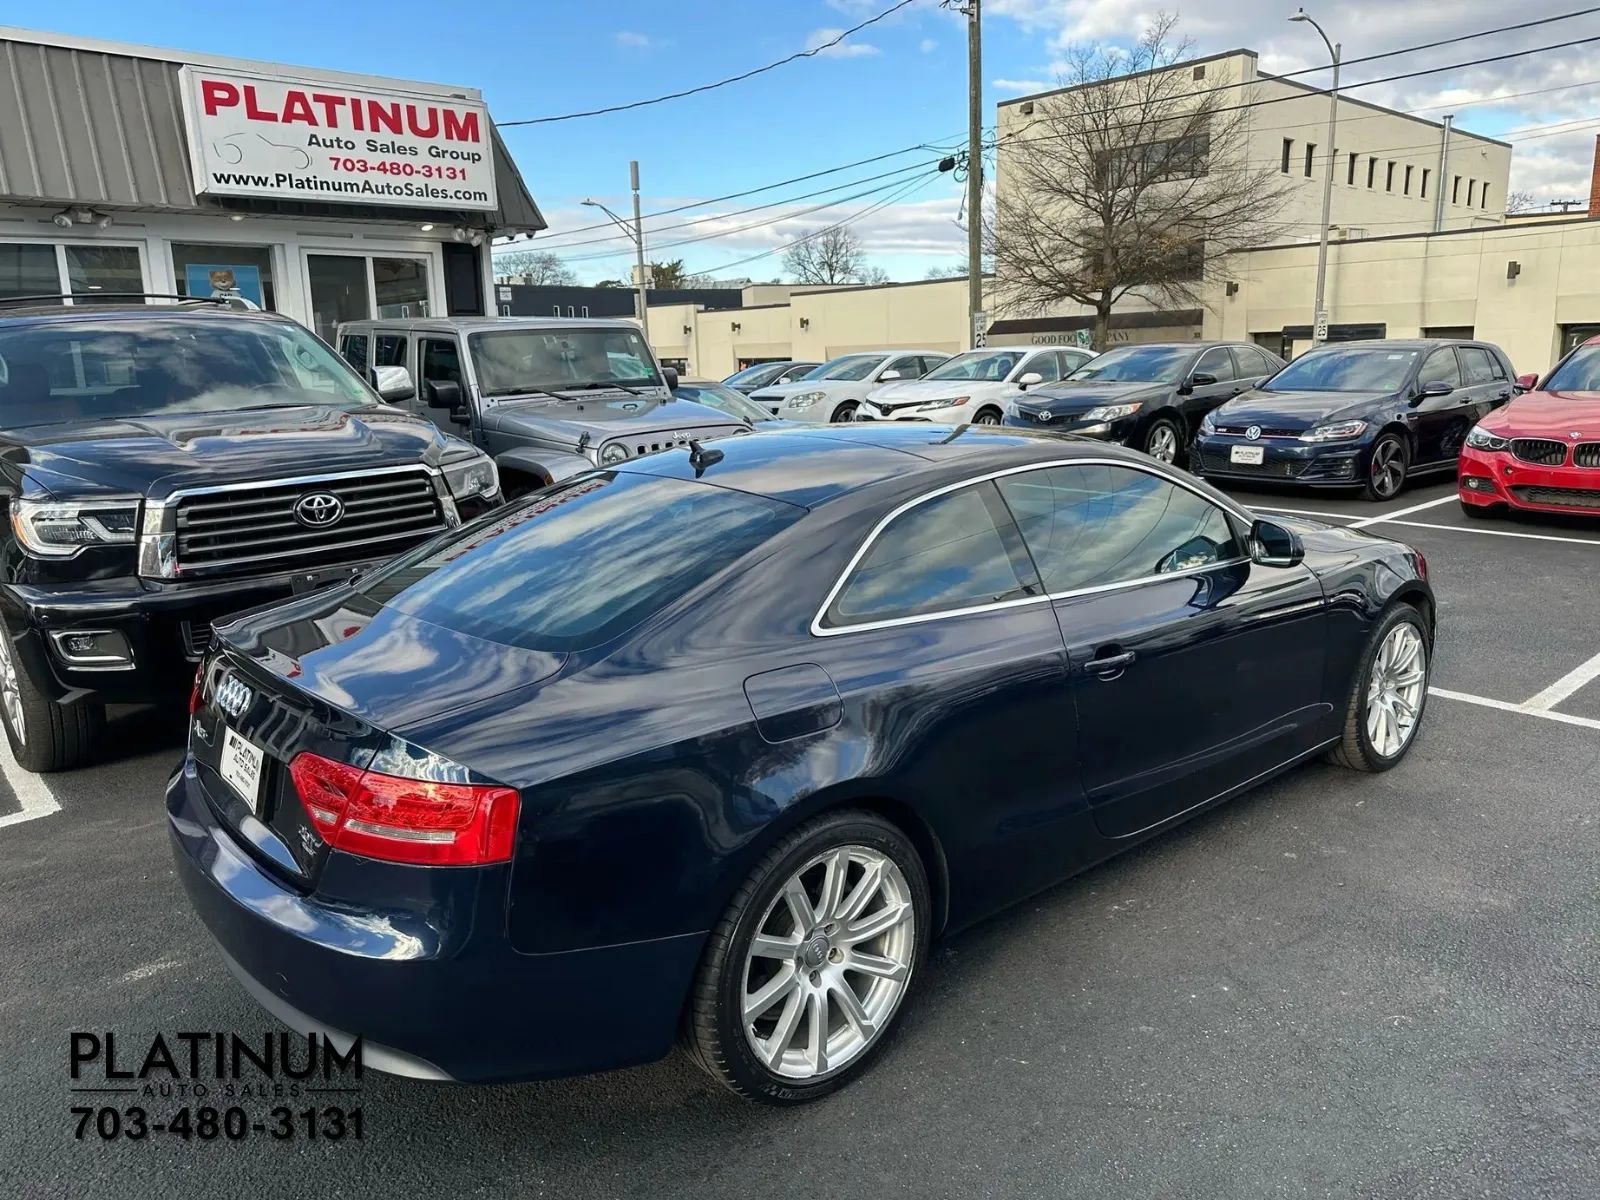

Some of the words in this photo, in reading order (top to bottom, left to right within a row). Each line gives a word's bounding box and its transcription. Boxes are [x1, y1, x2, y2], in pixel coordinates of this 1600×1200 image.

[201, 79, 481, 143] PLATINUM
[307, 133, 356, 151] Auto
[366, 139, 419, 157] Sales
[428, 145, 482, 164] Group
[329, 156, 467, 181] 703-480-3131
[212, 172, 488, 202] www.PlatinumAutoSales.com
[976, 333, 986, 348] 25
[1031, 335, 1057, 345] GOOD
[1058, 334, 1077, 344] FOO
[1318, 325, 1326, 336] 25
[672, 431, 691, 440] Jeep
